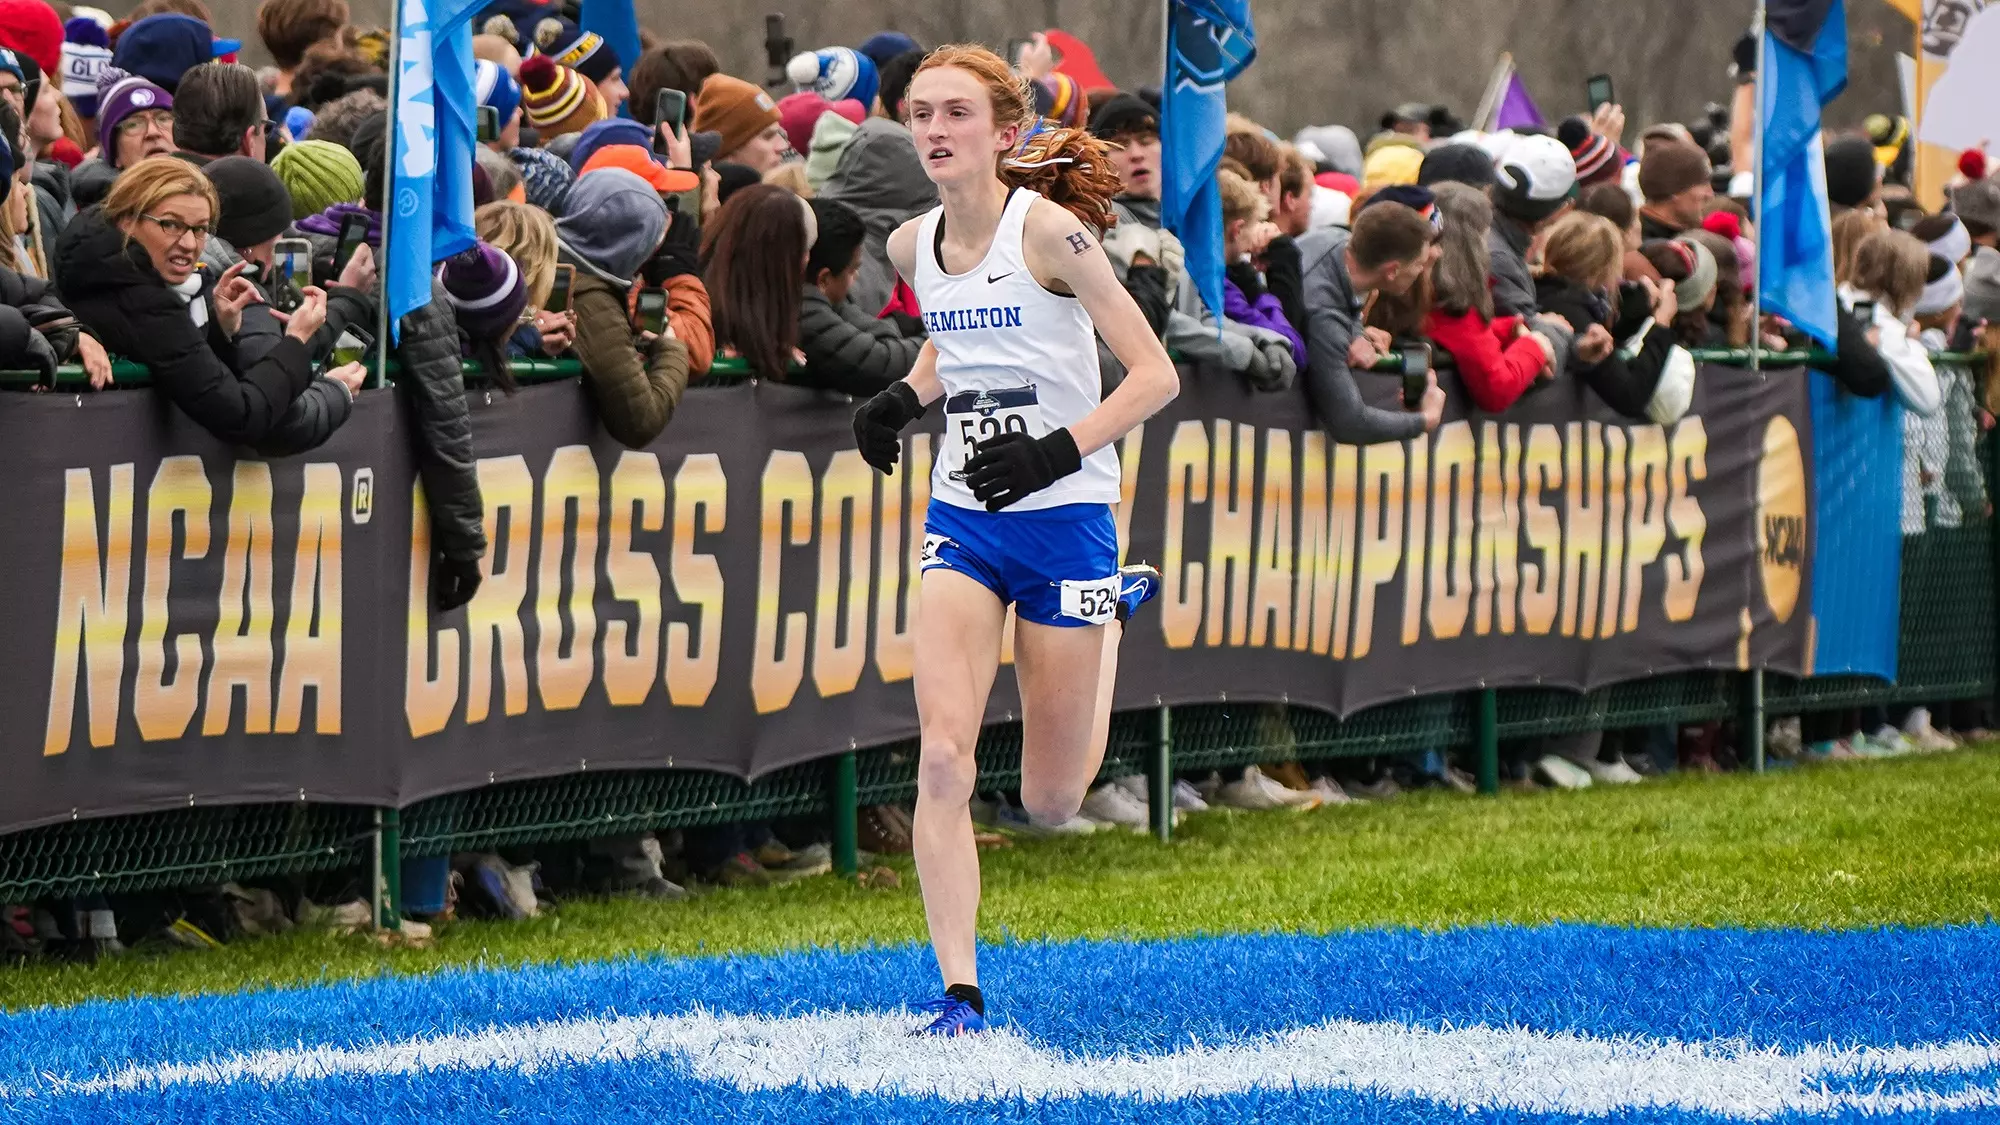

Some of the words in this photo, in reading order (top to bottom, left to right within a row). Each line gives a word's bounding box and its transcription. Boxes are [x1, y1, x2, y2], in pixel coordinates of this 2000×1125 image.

[1065, 231, 1092, 255] H
[405, 444, 727, 739] CROSS
[1161, 414, 1708, 661] CHAMPIONSHIPS
[1080, 585, 1117, 617] 529
